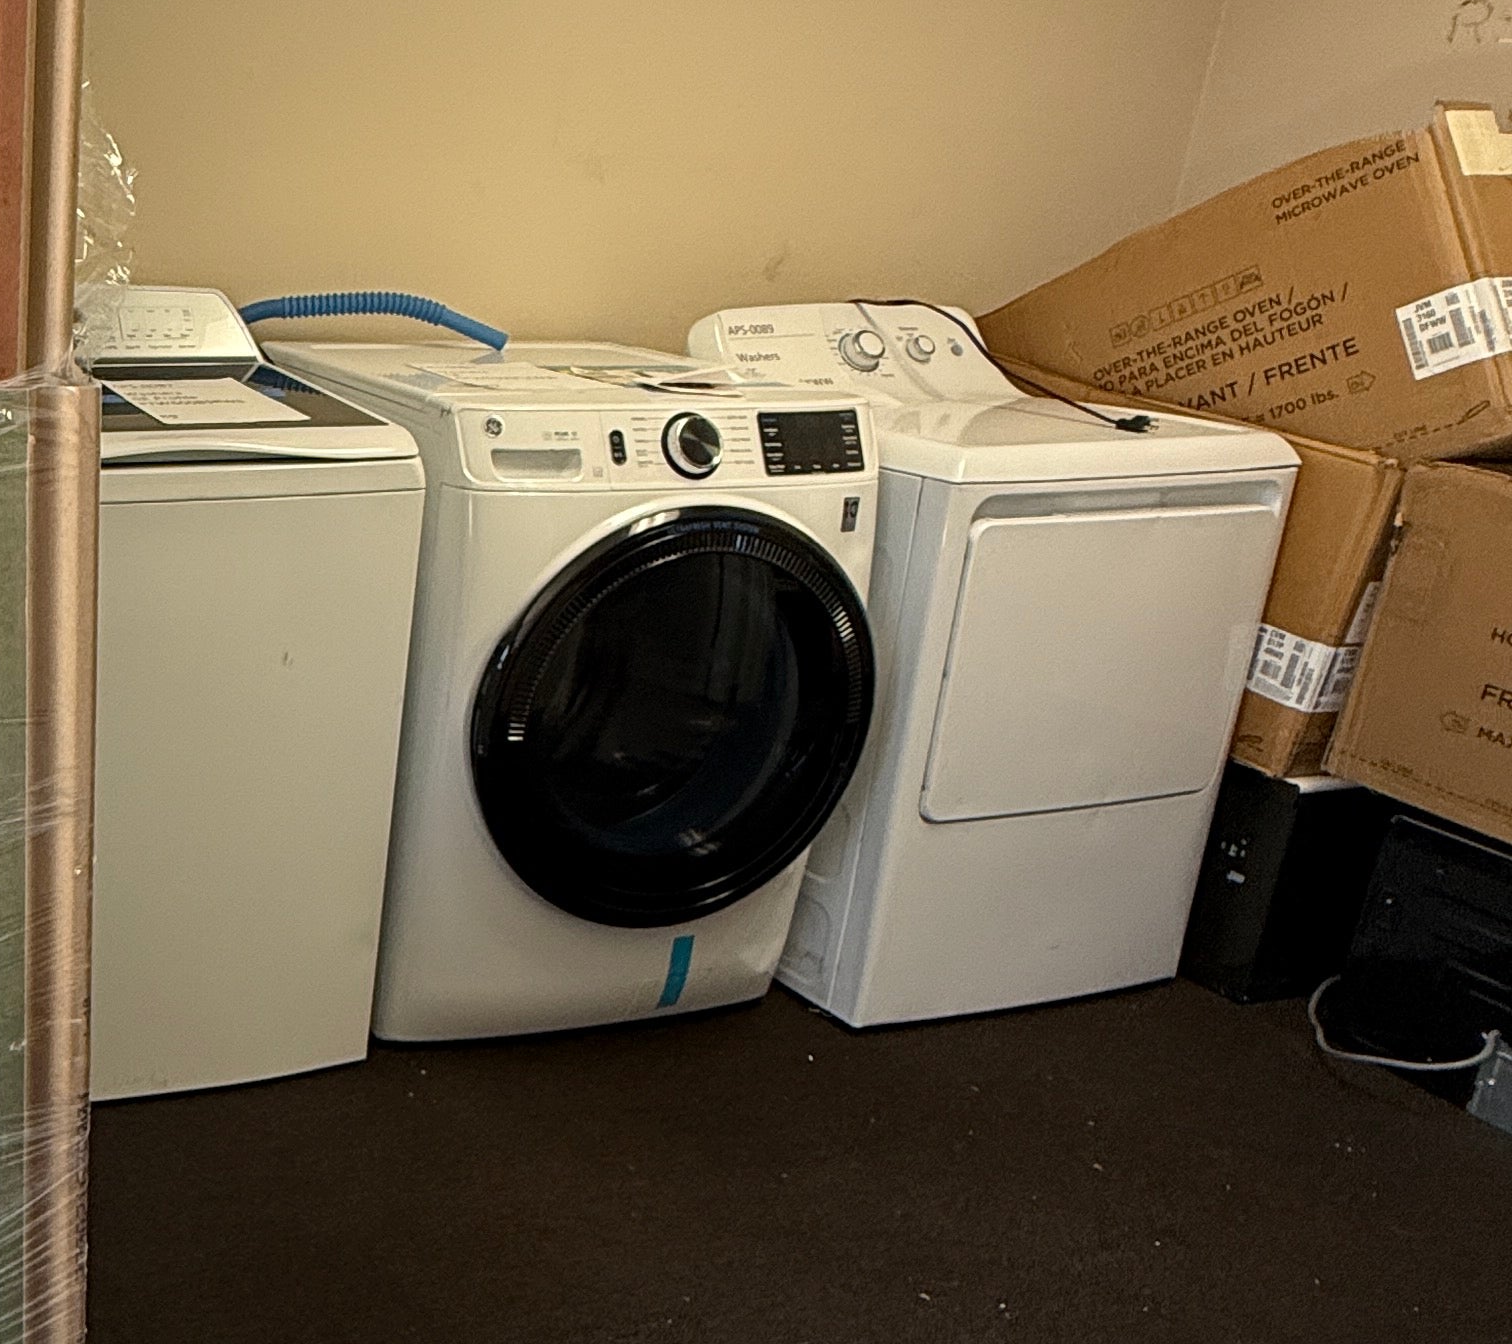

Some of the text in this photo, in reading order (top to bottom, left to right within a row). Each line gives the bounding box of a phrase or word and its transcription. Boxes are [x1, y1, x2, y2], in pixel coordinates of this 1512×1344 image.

[1272, 139, 1406, 209] OVER-THE-RANGE
[1275, 152, 1420, 225] MICROWAVE OVEN
[736, 352, 781, 362] Washers
[1092, 316, 1231, 381] OVER-THE-RANGE
[1233, 293, 1282, 324] OVEN
[1118, 362, 1160, 387] PARA
[1162, 337, 1227, 370] ENCIMA
[1229, 320, 1264, 343] DEL
[1268, 289, 1336, 327] FOGÓN
[1145, 359, 1208, 392] PLACER
[1212, 347, 1234, 367] EN
[1239, 312, 1324, 355] HAUTEUR
[1263, 336, 1360, 386] FRENTE
[1269, 397, 1307, 420] 1700
[1310, 386, 1340, 406] lbs.
